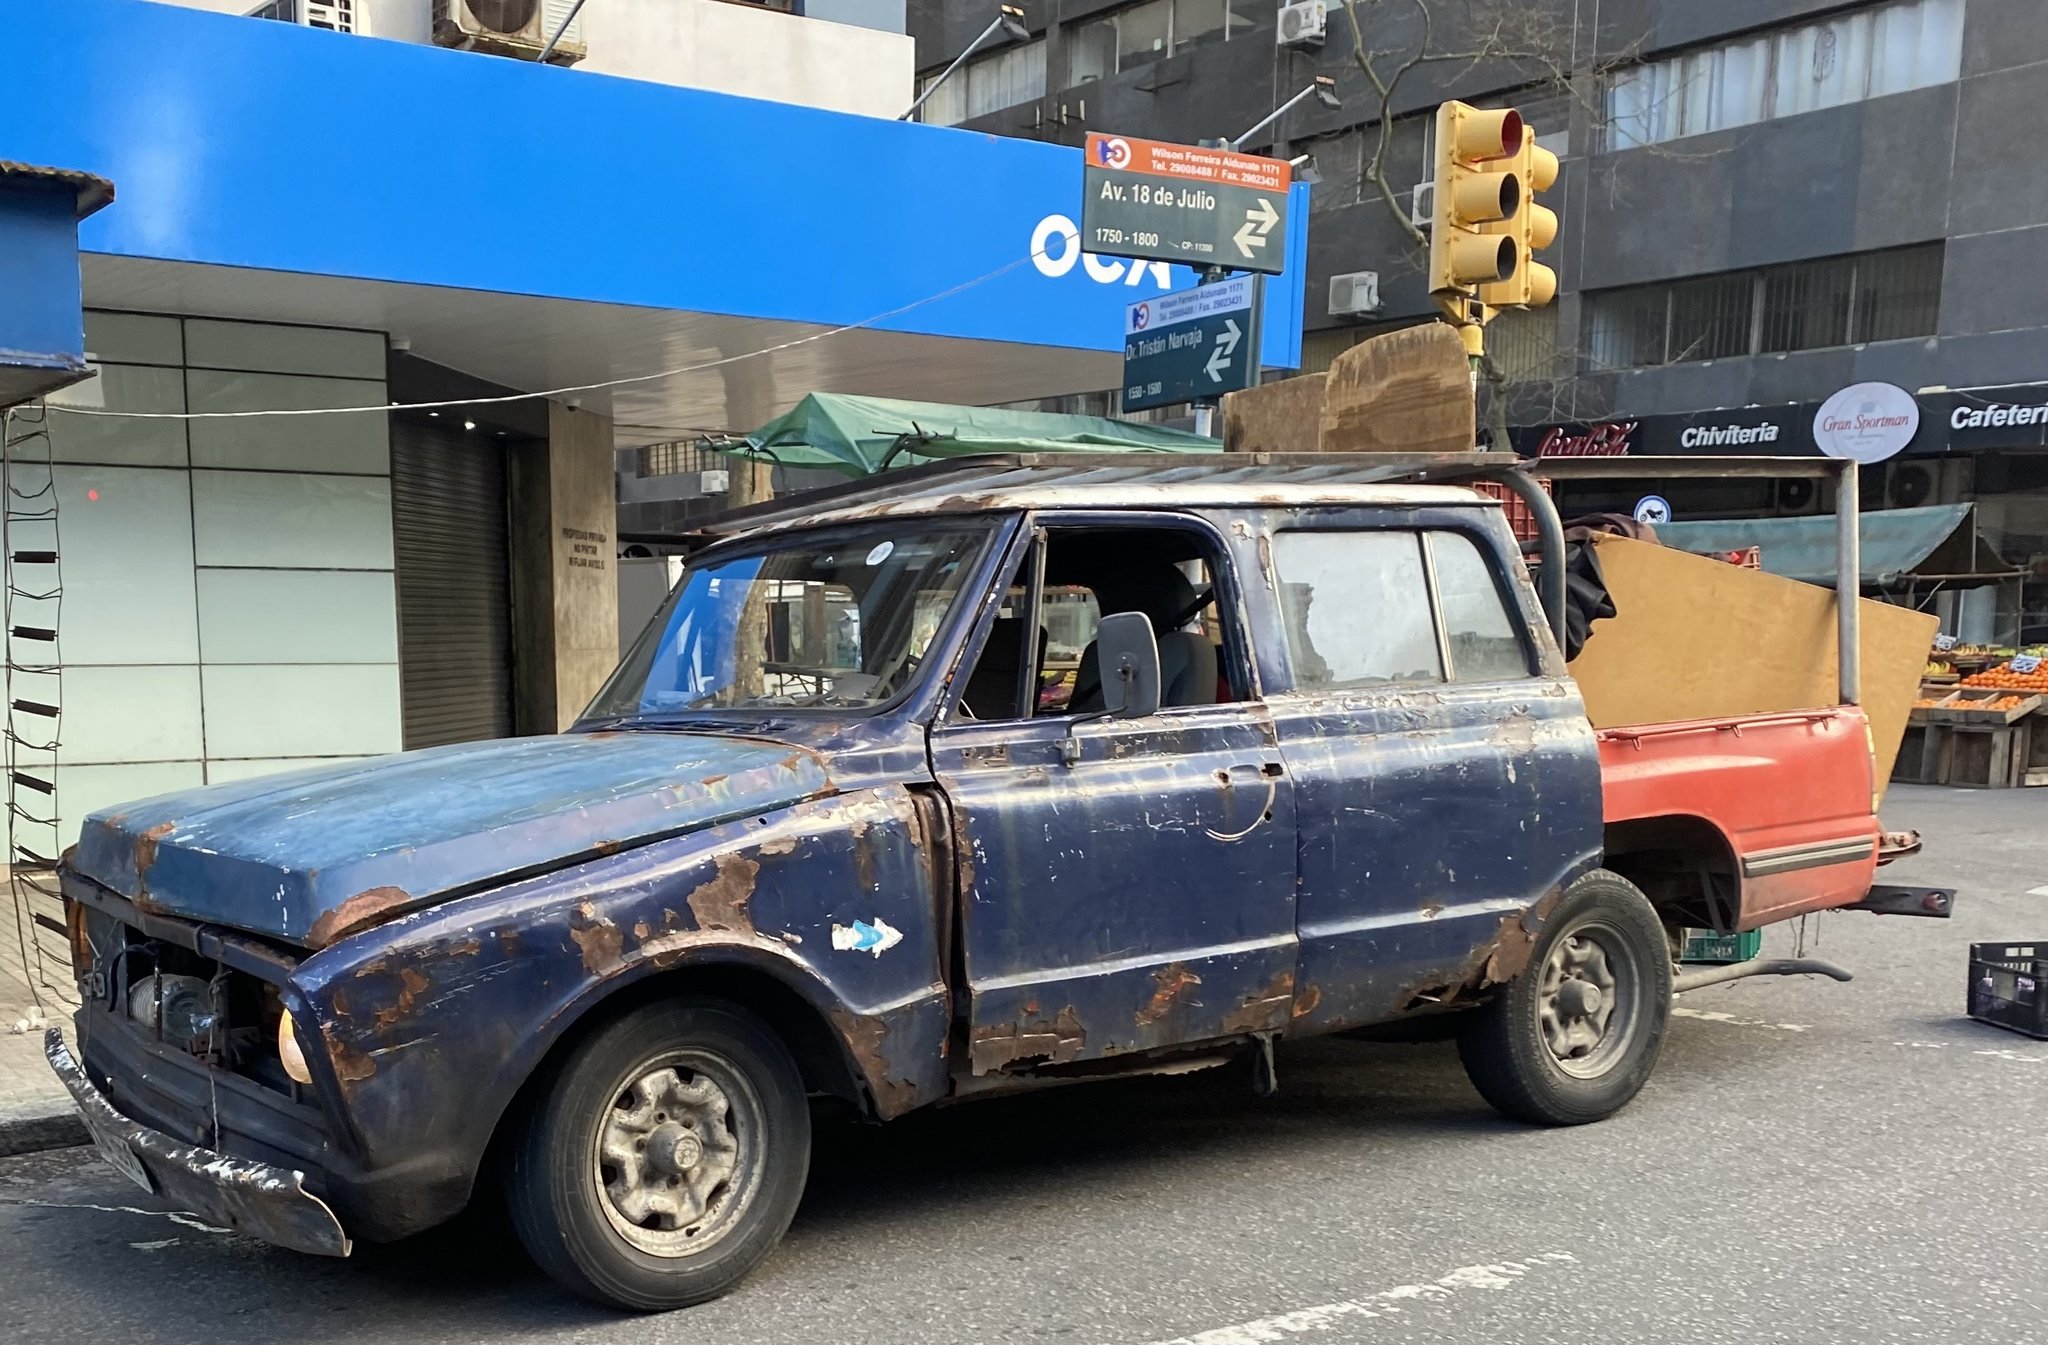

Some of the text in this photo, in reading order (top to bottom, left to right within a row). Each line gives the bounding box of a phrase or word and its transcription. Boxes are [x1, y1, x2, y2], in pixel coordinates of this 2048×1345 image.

[1151, 146, 1280, 175] Wilson Ferreira Aldunate 1171
[1151, 160, 1167, 171] Tel.
[1222, 169, 1239, 180] Fax.
[1101, 180, 1216, 210] Av. 18 de Julio
[1096, 228, 1123, 244] 1750
[1132, 232, 1159, 247] 1800
[1229, 282, 1244, 293] 1171
[1126, 326, 1203, 360] Dr. Tristán Narvaja
[1823, 413, 1910, 436] Gran Sportman
